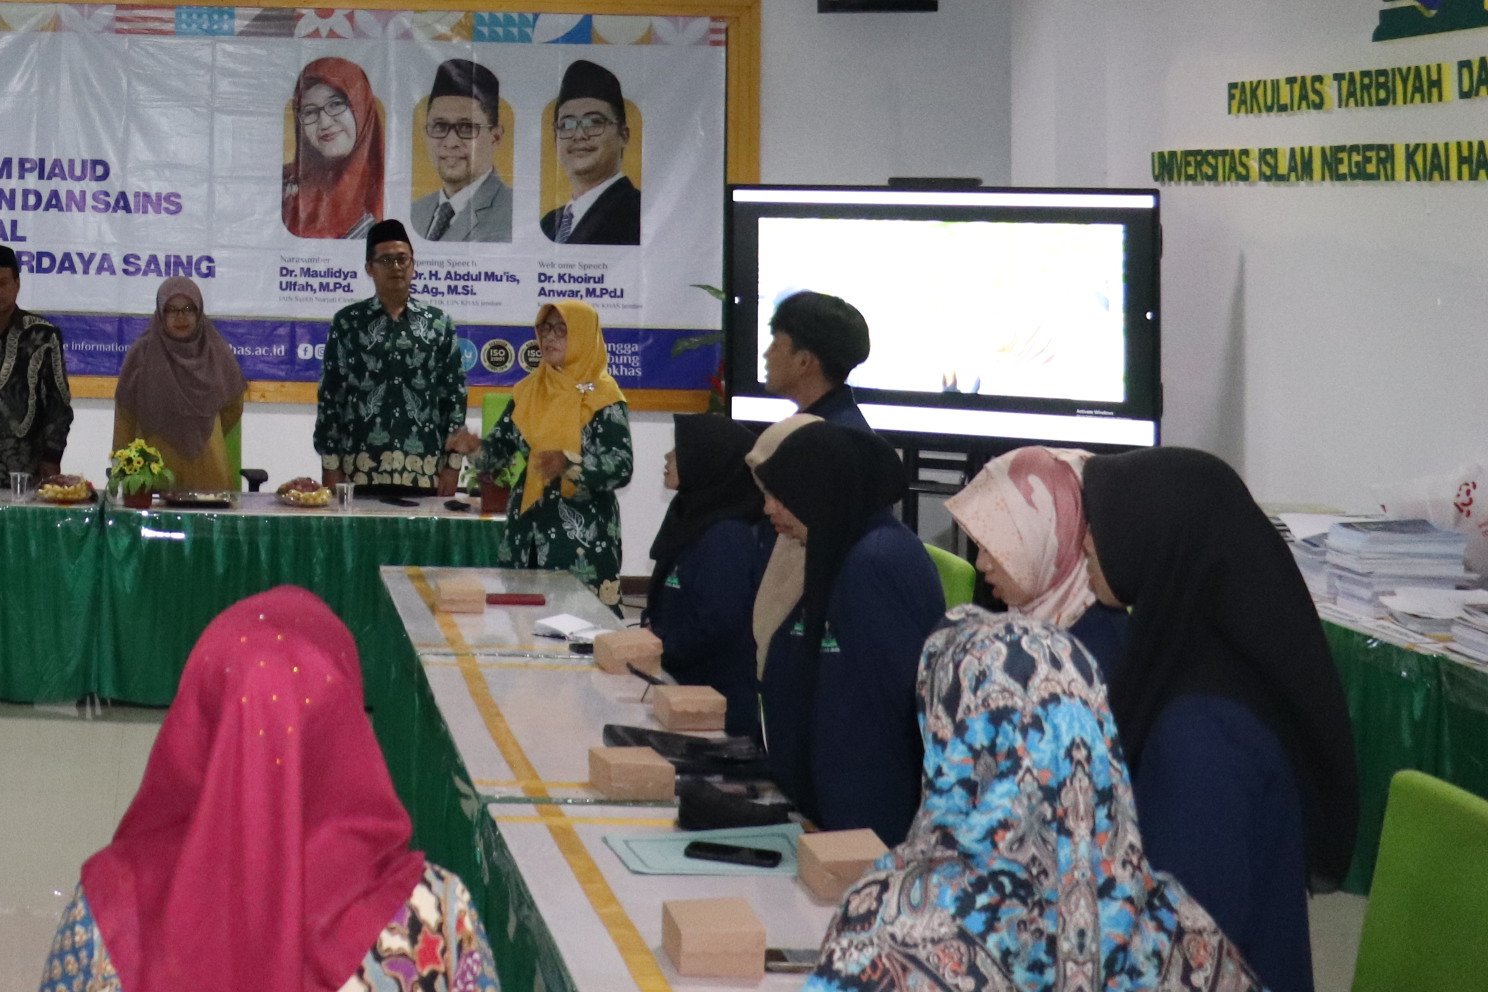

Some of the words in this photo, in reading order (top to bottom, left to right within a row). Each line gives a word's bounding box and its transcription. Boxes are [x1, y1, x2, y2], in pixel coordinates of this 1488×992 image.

[1227, 74, 1327, 116] FAKULTAS
[1332, 63, 1445, 109] TARBIYAH
[1258, 146, 1314, 182] ISLAM
[1320, 144, 1396, 182] NEGERI
[1404, 142, 1450, 182] KIAI
[18, 158, 110, 182] PIAUD
[21, 188, 86, 212] DAN
[90, 190, 182, 216] SAINS
[122, 253, 216, 278] SAING
[279, 266, 298, 278] Dr.
[300, 267, 358, 280] Maulidya
[428, 270, 441, 280] H.
[444, 270, 482, 282] Abdul
[538, 272, 555, 283] Dr.
[558, 273, 604, 284] Khoirul
[279, 280, 316, 294] Ulfah,
[318, 282, 354, 292] M.Pd.
[447, 285, 476, 296] M.Si.
[538, 287, 583, 300] Anwar,
[490, 349, 506, 357] ISO
[527, 349, 542, 357] ISO
